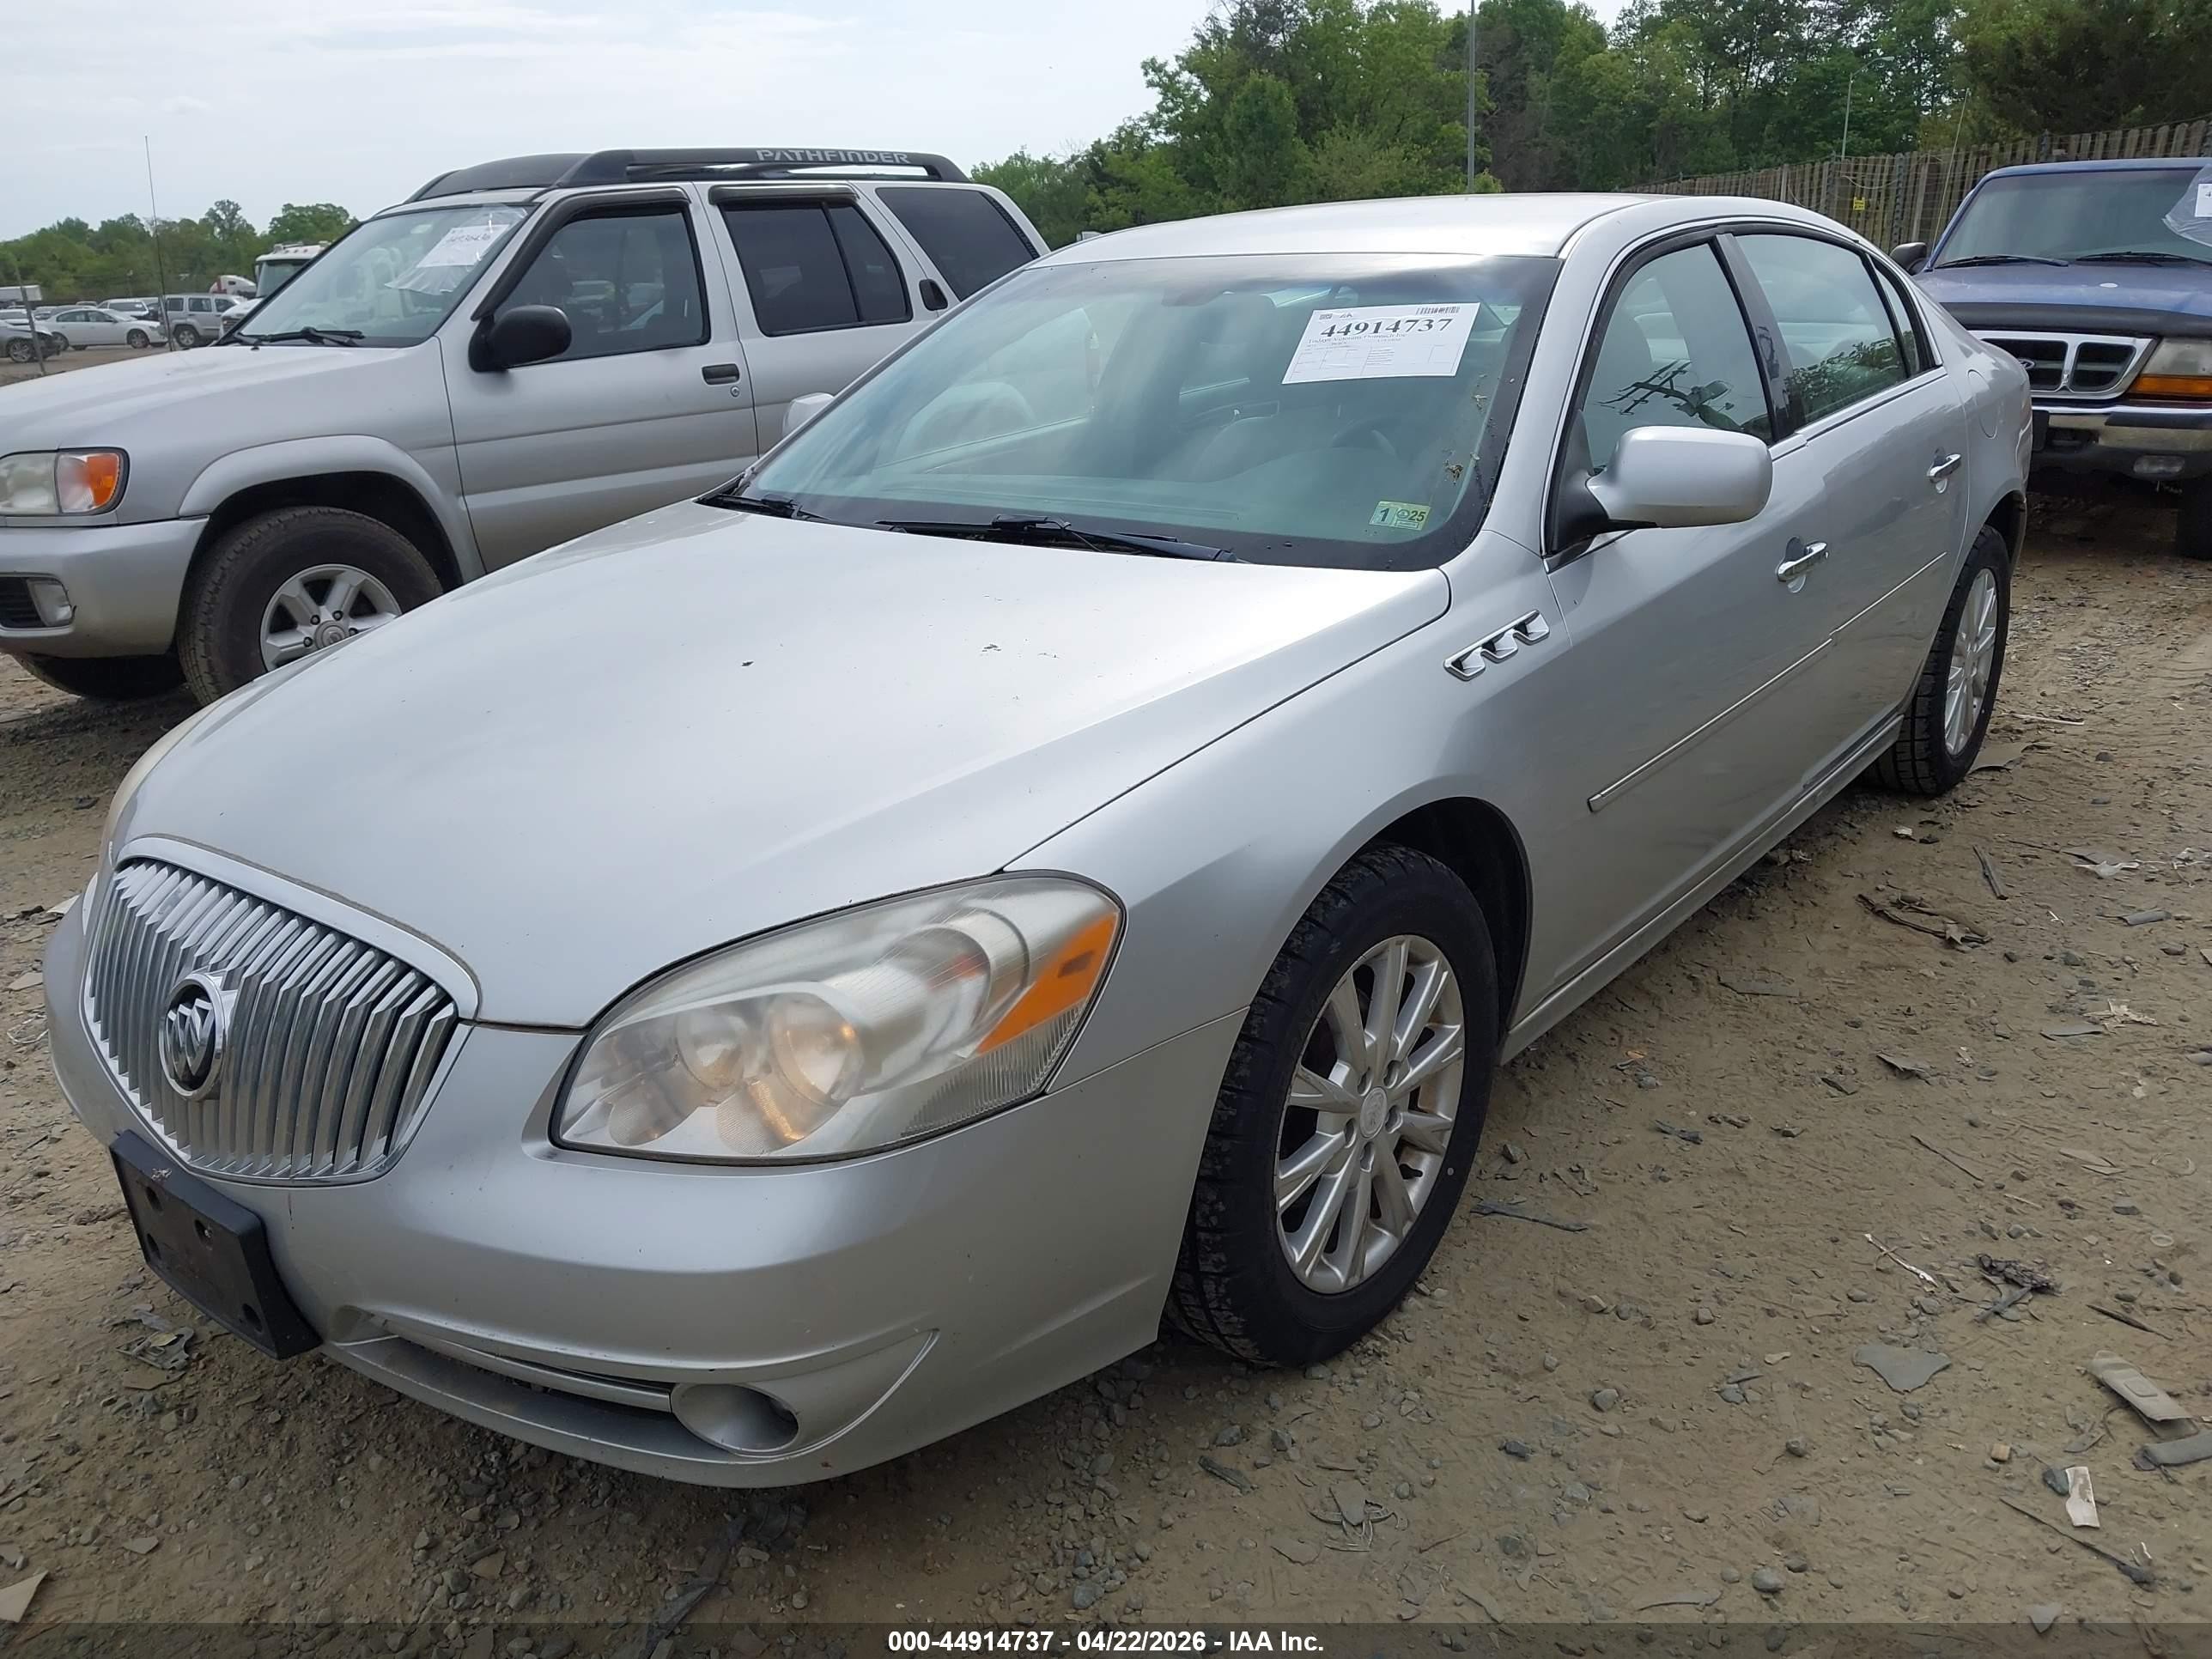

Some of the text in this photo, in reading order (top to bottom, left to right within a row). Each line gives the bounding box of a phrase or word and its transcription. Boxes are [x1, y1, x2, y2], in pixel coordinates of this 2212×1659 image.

[756, 149, 911, 164] PATHFINDER
[1321, 317, 1453, 337] 44914737
[1380, 507, 1426, 522] 1 25
